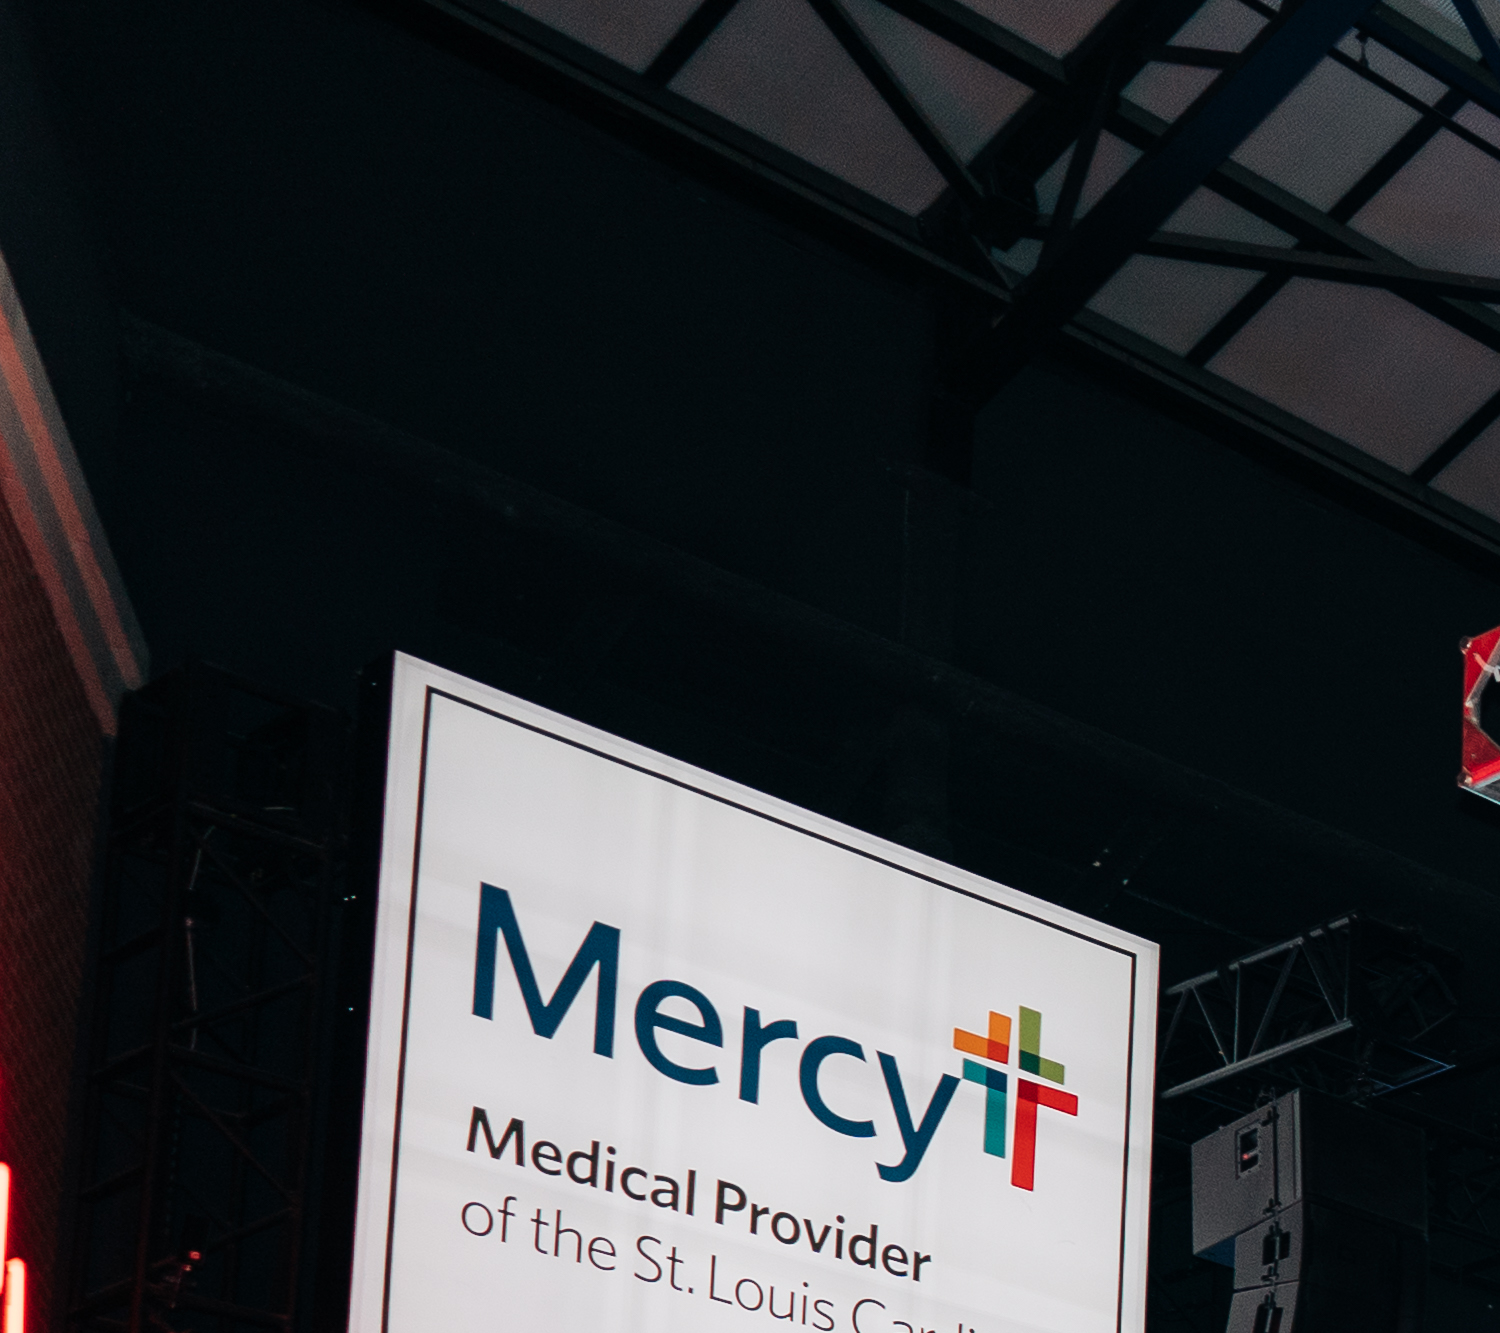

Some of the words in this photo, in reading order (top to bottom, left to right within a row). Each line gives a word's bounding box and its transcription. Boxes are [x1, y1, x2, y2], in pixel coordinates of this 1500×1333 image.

[470, 880, 962, 1184] Mercy
[460, 1196, 516, 1239] of
[531, 1207, 618, 1273] the
[634, 1234, 695, 1294] St.
[710, 1255, 837, 1333] Louis
[465, 1106, 696, 1217] Medical
[714, 1178, 932, 1283] Provider
